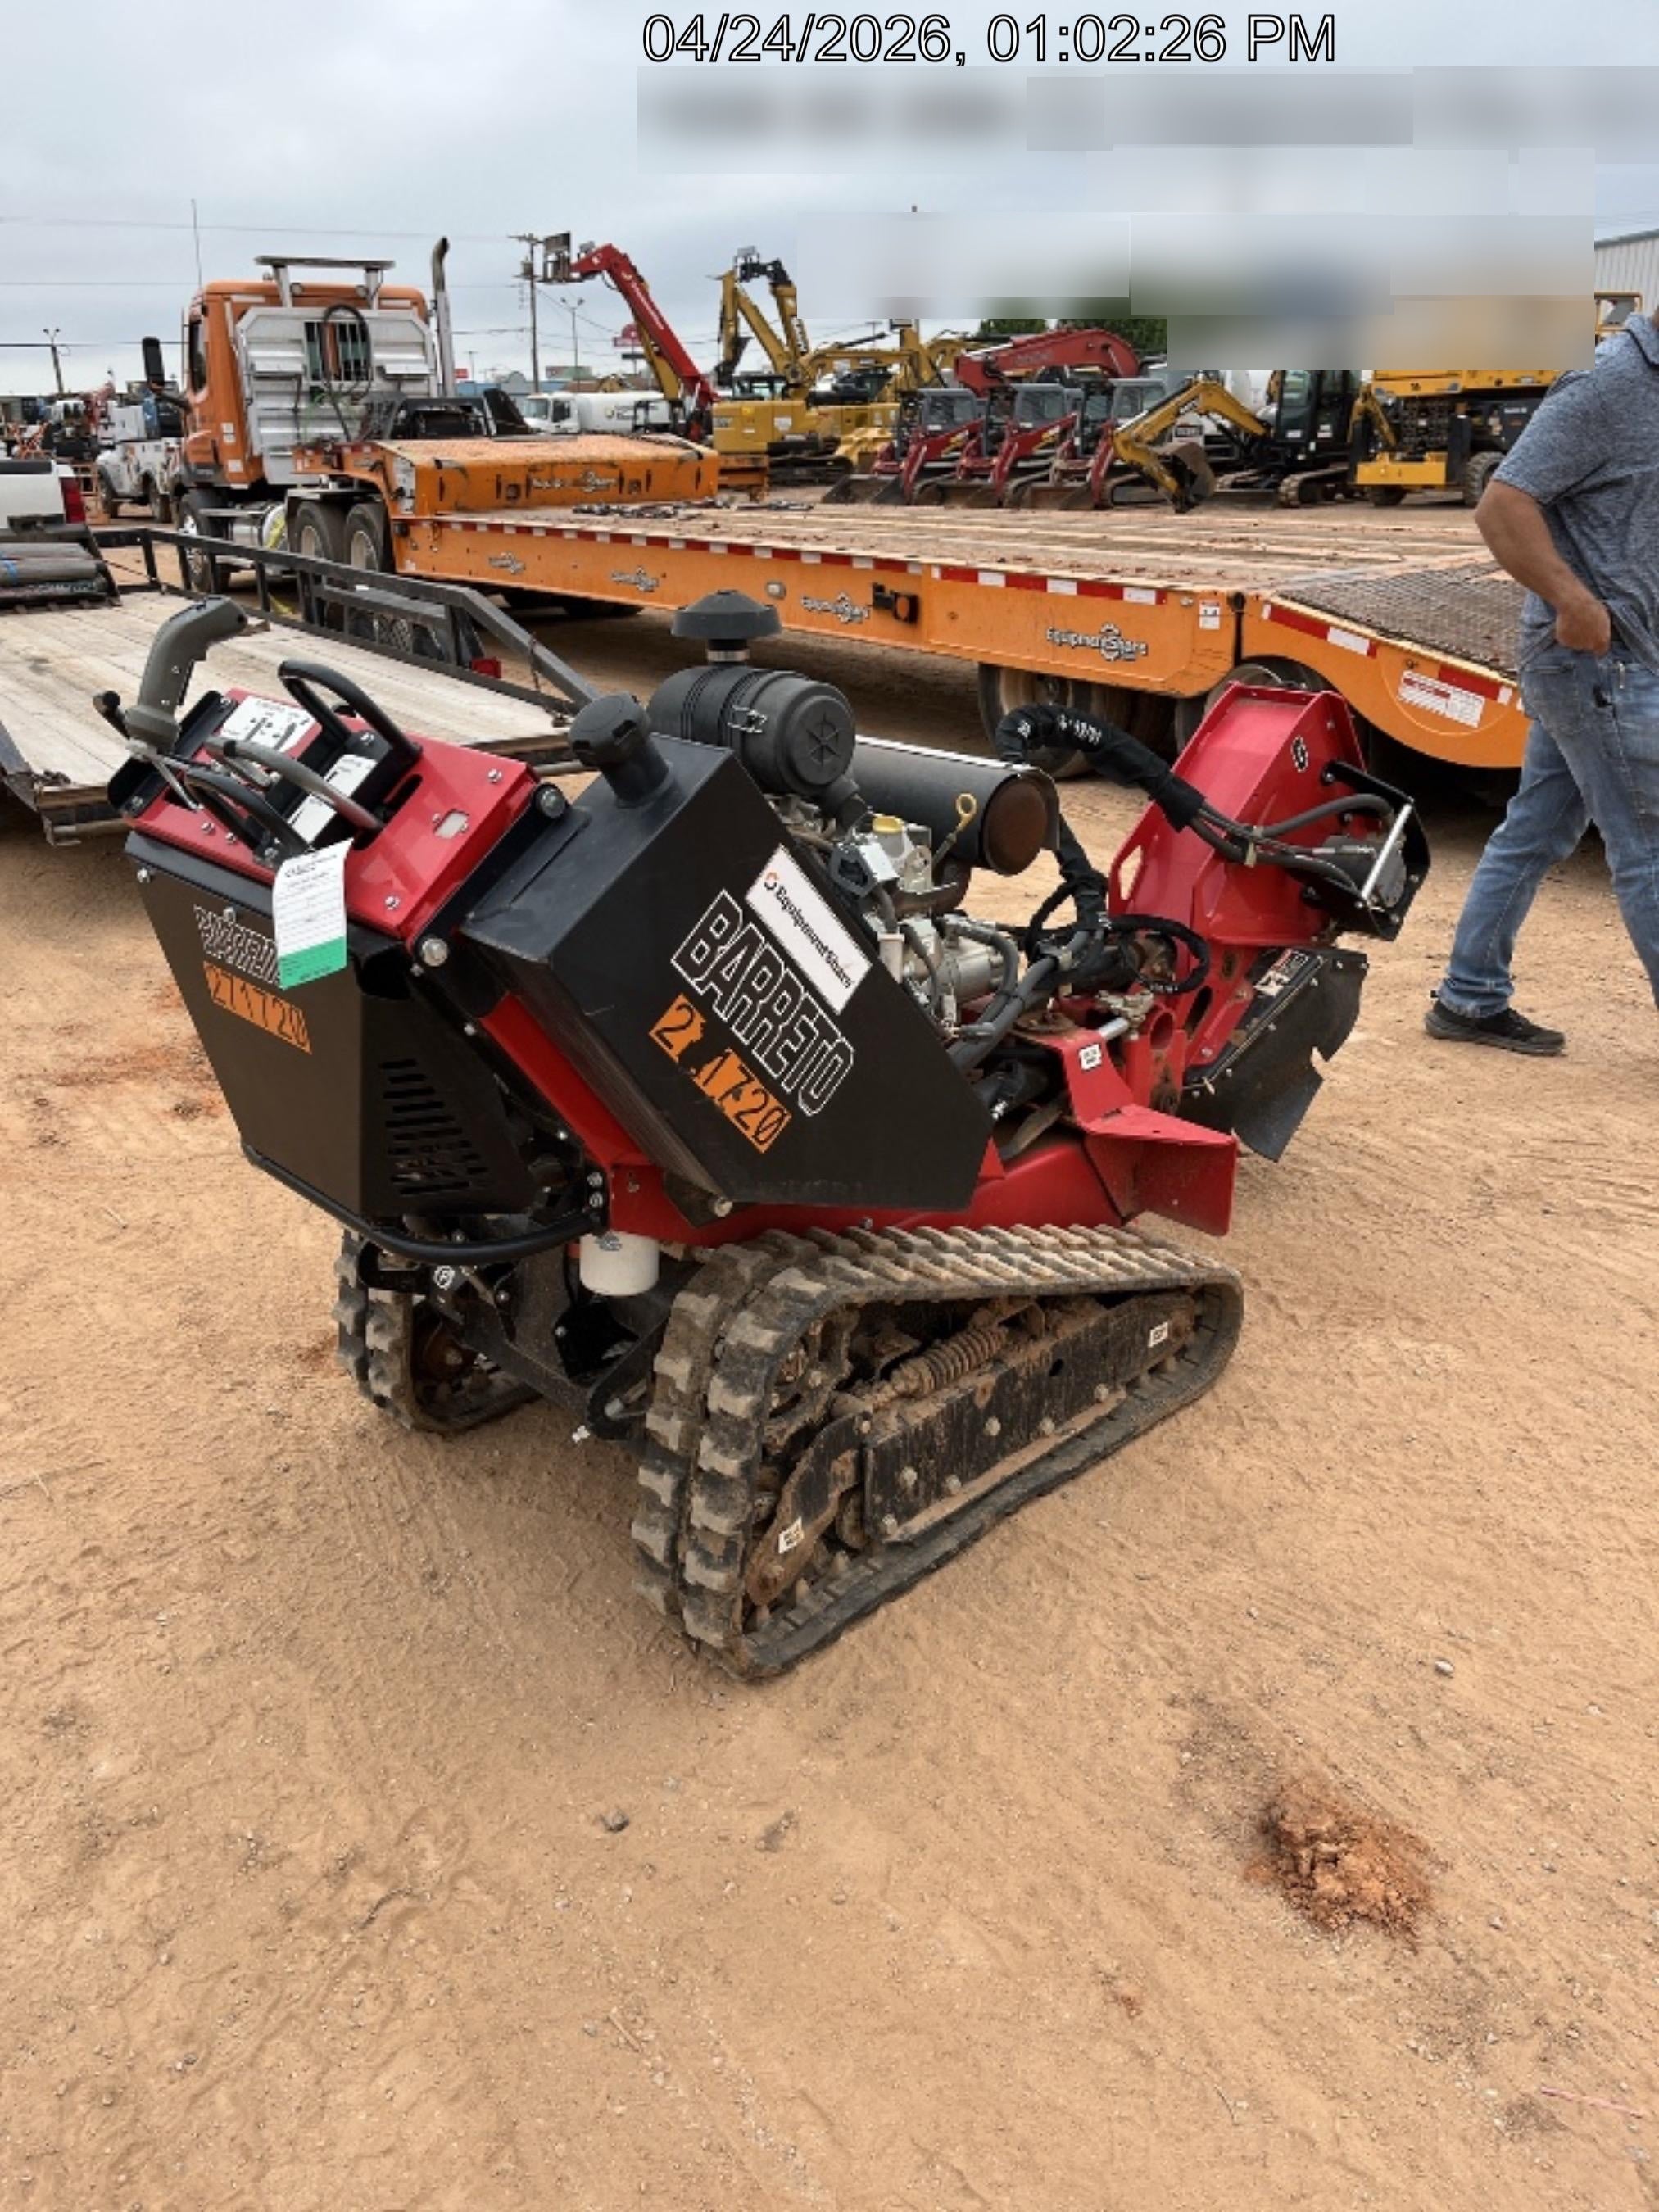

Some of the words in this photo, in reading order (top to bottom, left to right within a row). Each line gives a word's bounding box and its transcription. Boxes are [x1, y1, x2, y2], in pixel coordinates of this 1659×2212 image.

[193, 904, 281, 986] BARRET
[775, 885, 853, 989] EquipmentShare
[670, 889, 854, 1117] BARRETO
[653, 1004, 790, 1147] 21720
